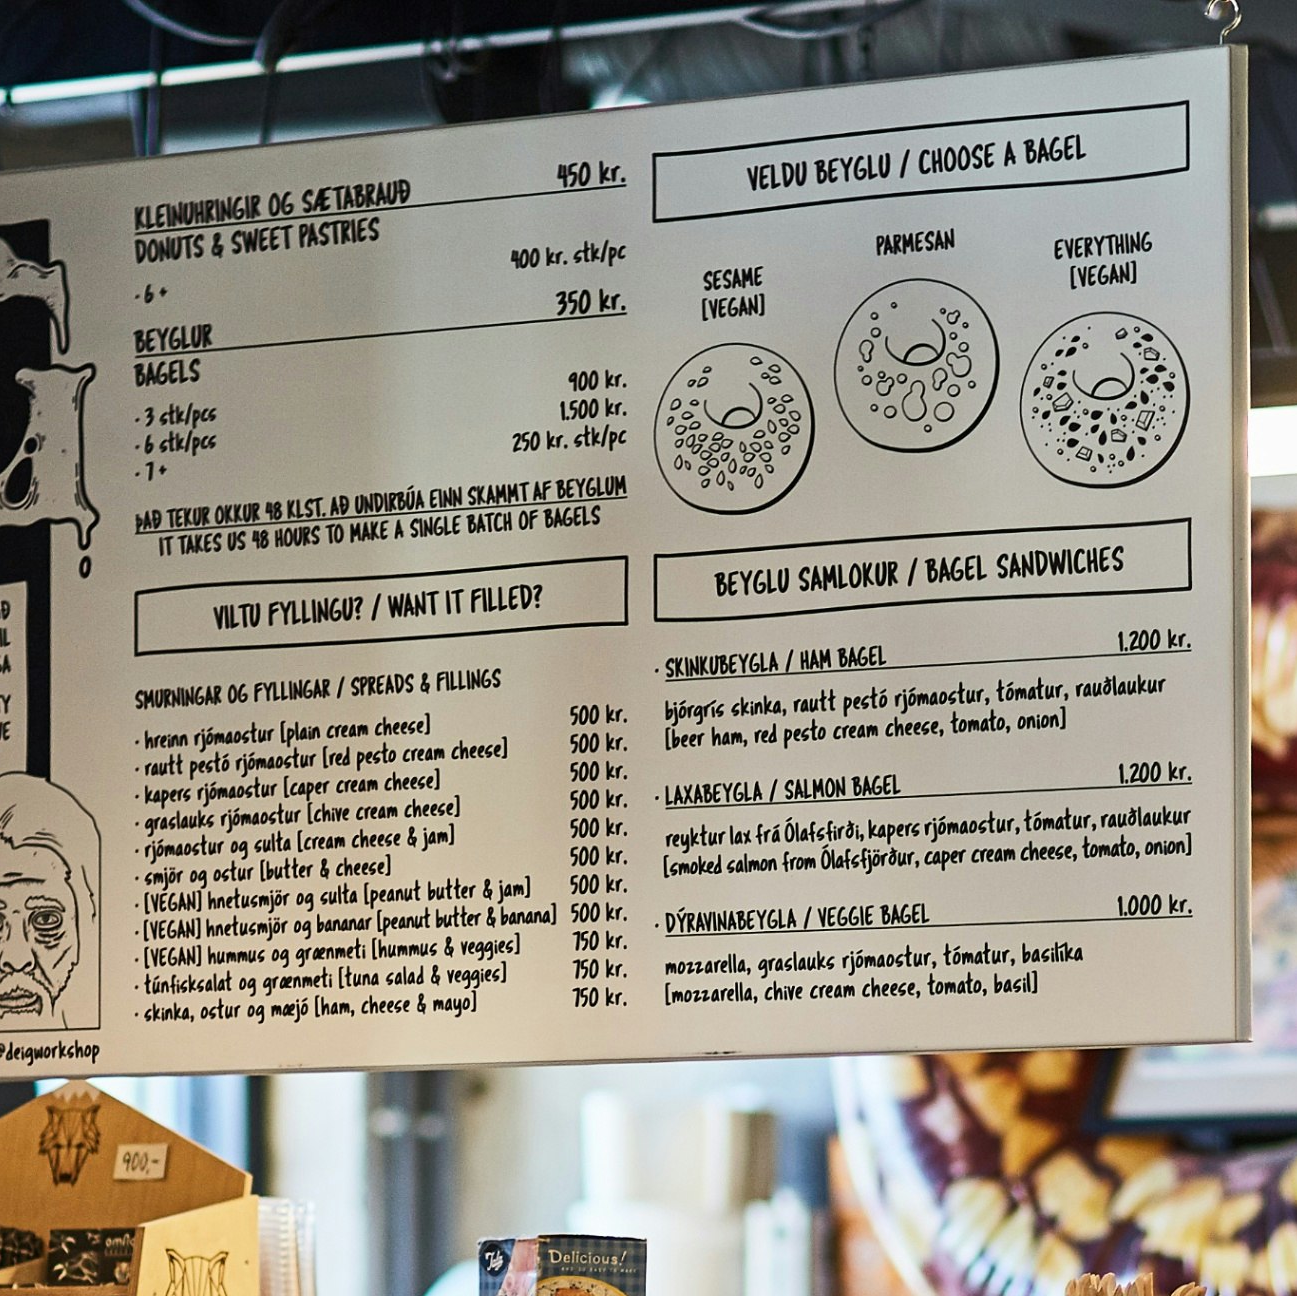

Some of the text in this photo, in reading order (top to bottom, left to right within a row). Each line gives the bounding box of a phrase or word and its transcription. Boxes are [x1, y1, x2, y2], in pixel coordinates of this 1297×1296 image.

[557, 161, 626, 188] 450 kr.
[747, 134, 1086, 191] VELDU BEYGLU / CHOOSE A BAGEL
[135, 179, 410, 230] KLEINUHRINGIR OG SÆTABRAUÐ
[135, 217, 379, 264] DONUTS & SWEET PASTRIES
[876, 228, 955, 256] PARMESAN
[1054, 232, 1152, 260] EVERYTHING
[703, 266, 763, 291] SESAME
[1070, 260, 1136, 290] [VEGAN]
[556, 289, 626, 316] 350 kr.
[702, 293, 765, 321] [VEGAN]
[133, 324, 213, 353] BEYGLUR
[133, 358, 200, 387] BAGELS
[568, 370, 626, 391] 900 kr.
[145, 403, 216, 429] 3 stk/pcs
[159, 505, 600, 556] IT TAKES US 48 HOURS TO MAKE A SINGLE BATCH OF BAGELS
[714, 546, 1124, 597] BEYGLU SAMLOKUR / BAGEL SANDWICHES
[213, 584, 542, 630] VILTU FYLLINGU? / WANT IT FILLED?
[1118, 629, 1191, 652] 1.200 kr.
[665, 645, 887, 678] SKINKUBEYGLA / HAM BAGEL
[570, 704, 627, 725] 500 kr.
[145, 713, 430, 749] hreinn rjómaostur [plain cream cheese]
[665, 903, 930, 933] DÝRAVINABEYGLA / VEGGIE BAGEL
[1118, 894, 1192, 916] 1.000 kr.
[548, 1249, 627, 1266] Delicious!
